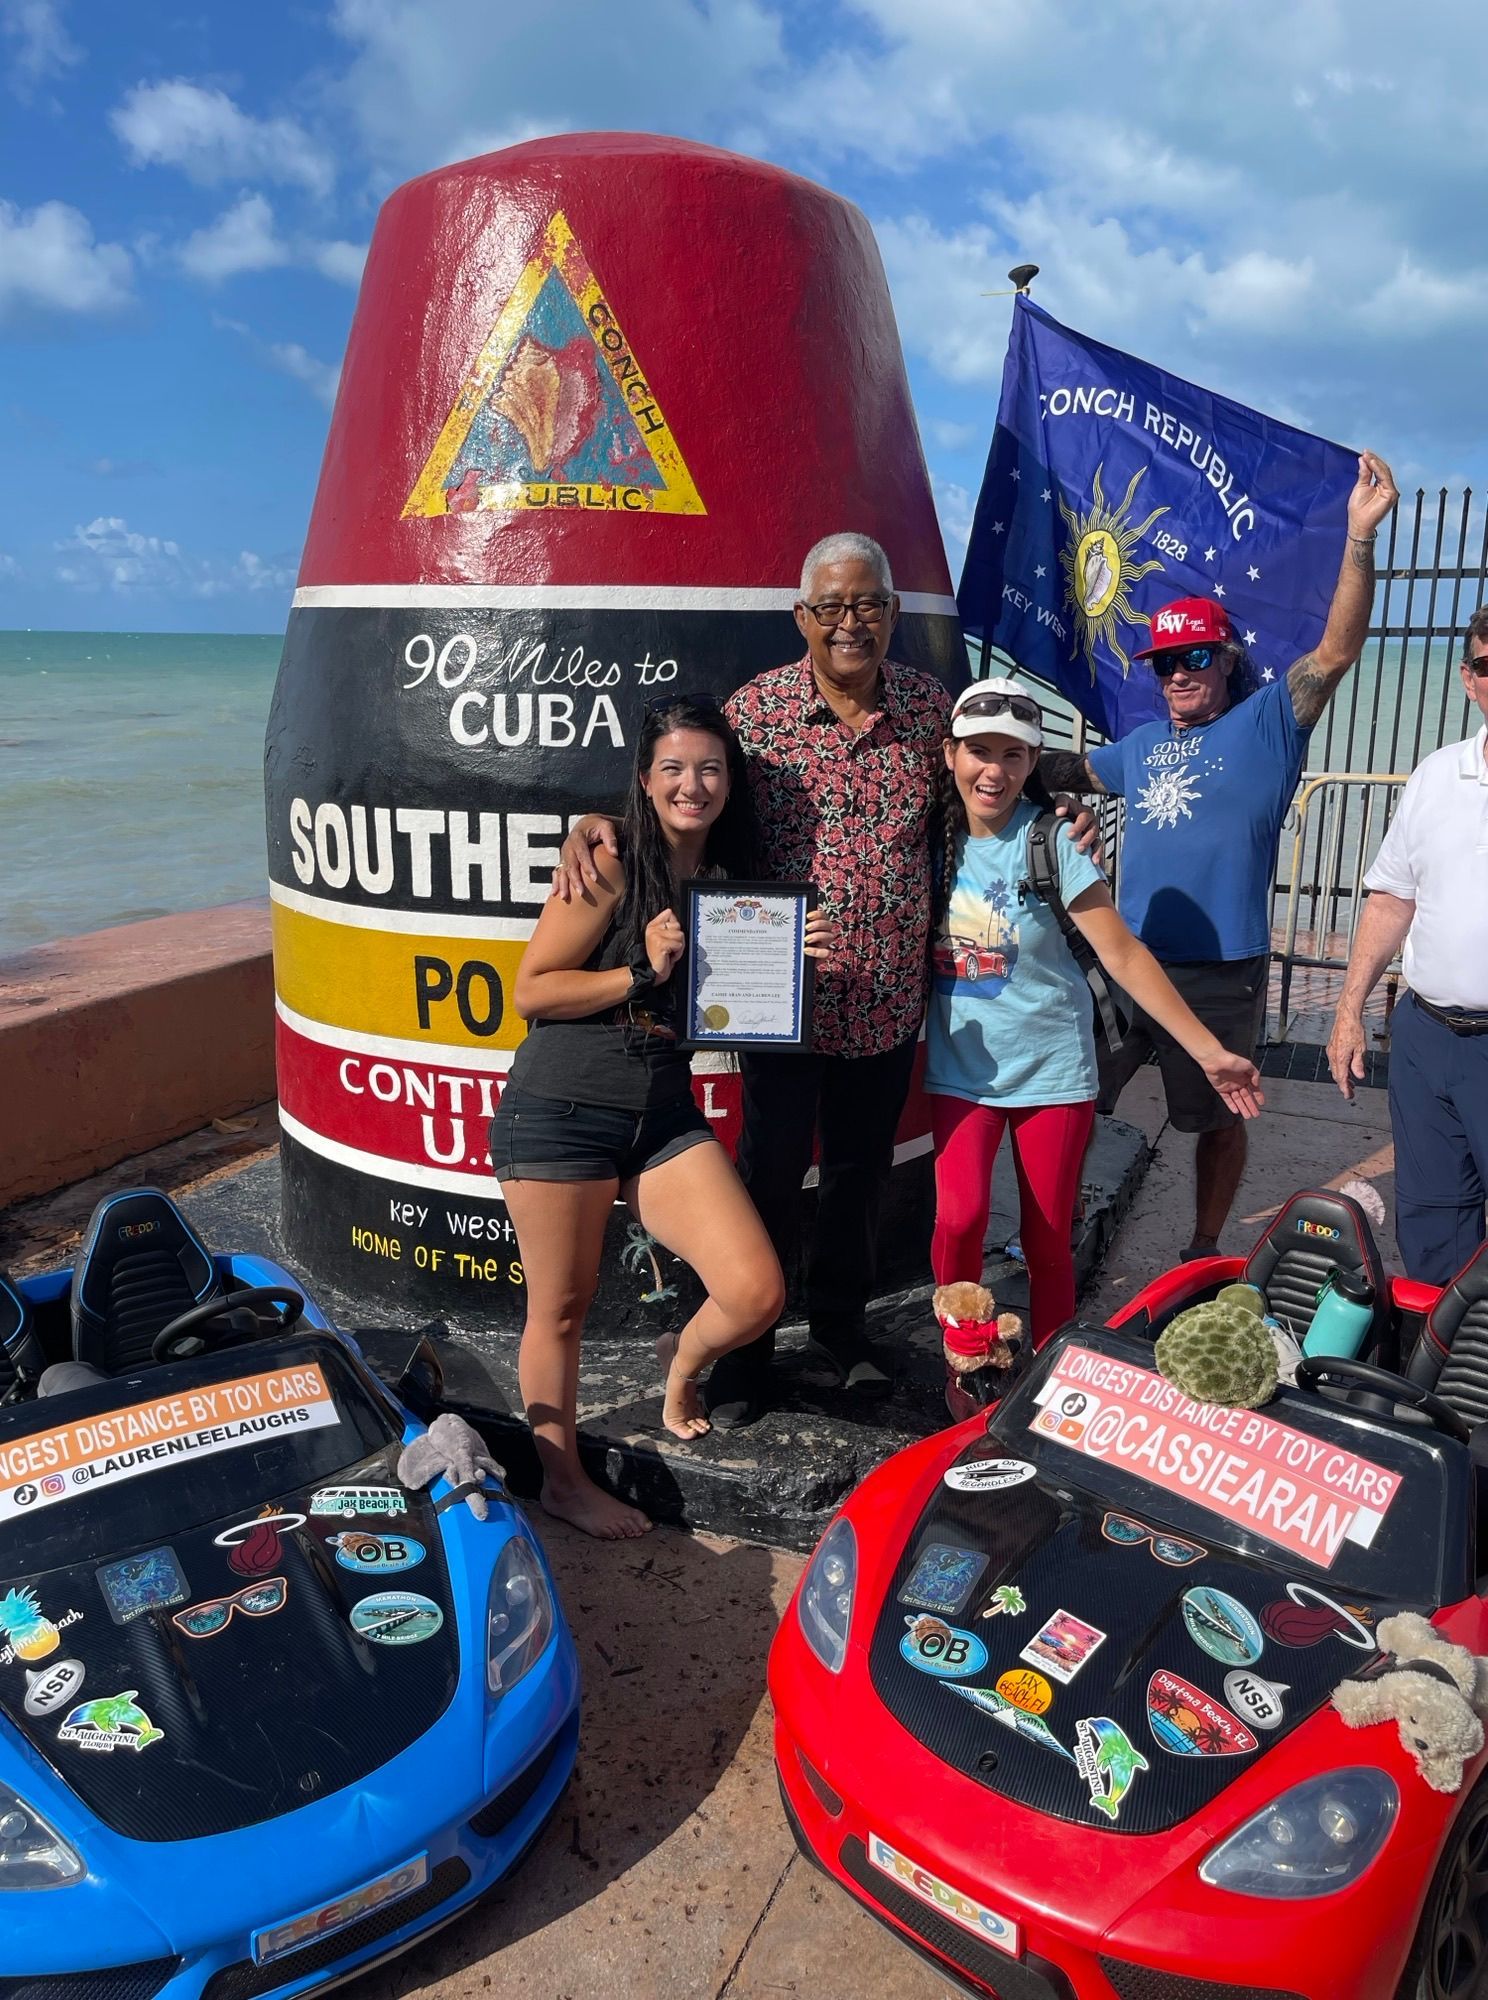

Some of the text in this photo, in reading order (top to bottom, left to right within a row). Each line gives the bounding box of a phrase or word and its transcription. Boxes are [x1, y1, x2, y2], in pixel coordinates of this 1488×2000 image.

[588, 303, 665, 435] CONCH
[1143, 401, 1255, 541] REPUBLIC
[1151, 529, 1189, 562] 1828
[1001, 583, 1067, 642] KEY WEST
[1156, 609, 1187, 634] KW
[403, 634, 678, 690] 90 Miles to
[449, 691, 625, 748] CUBA
[290, 797, 587, 904] SOUTHE
[415, 955, 529, 1037] PO
[340, 1058, 507, 1118] CONTI
[421, 1113, 493, 1167] U.
[1297, 1219, 1340, 1241] FREDDO
[415, 1246, 446, 1272] OF
[76, 1403, 187, 1457] DISTANCE
[192, 1393, 219, 1423] BY
[221, 1384, 263, 1413] TOY
[268, 1371, 322, 1402] CARS
[1057, 1350, 1392, 1505] LONGEST DISTANCE BY TOY CARS
[72, 1408, 310, 1485] @LAURENLEELAUGHS
[965, 1461, 991, 1471] RIDE
[959, 1474, 1026, 1487] REGARDLESS
[1084, 1404, 1354, 1557] @CASSIEARAN
[356, 1541, 407, 1563] OB
[1228, 1600, 1256, 1636] MARATHON
[919, 1633, 970, 1664] OB
[33, 1667, 75, 1706] NSB
[1016, 1672, 1042, 1695] JAX
[1031, 1698, 1045, 1711] FL
[1233, 1678, 1273, 1719] NSB
[60, 1729, 137, 1744] ST. AUGUSTINE
[1158, 1674, 1201, 1707] Daytona
[1234, 1731, 1249, 1749] FL
[82, 1740, 112, 1749] FLORIDA
[1081, 1736, 1103, 1796] AUGUSTINE
[268, 1867, 418, 1951] FREDDO
[876, 1839, 1007, 1937] FREDDO
